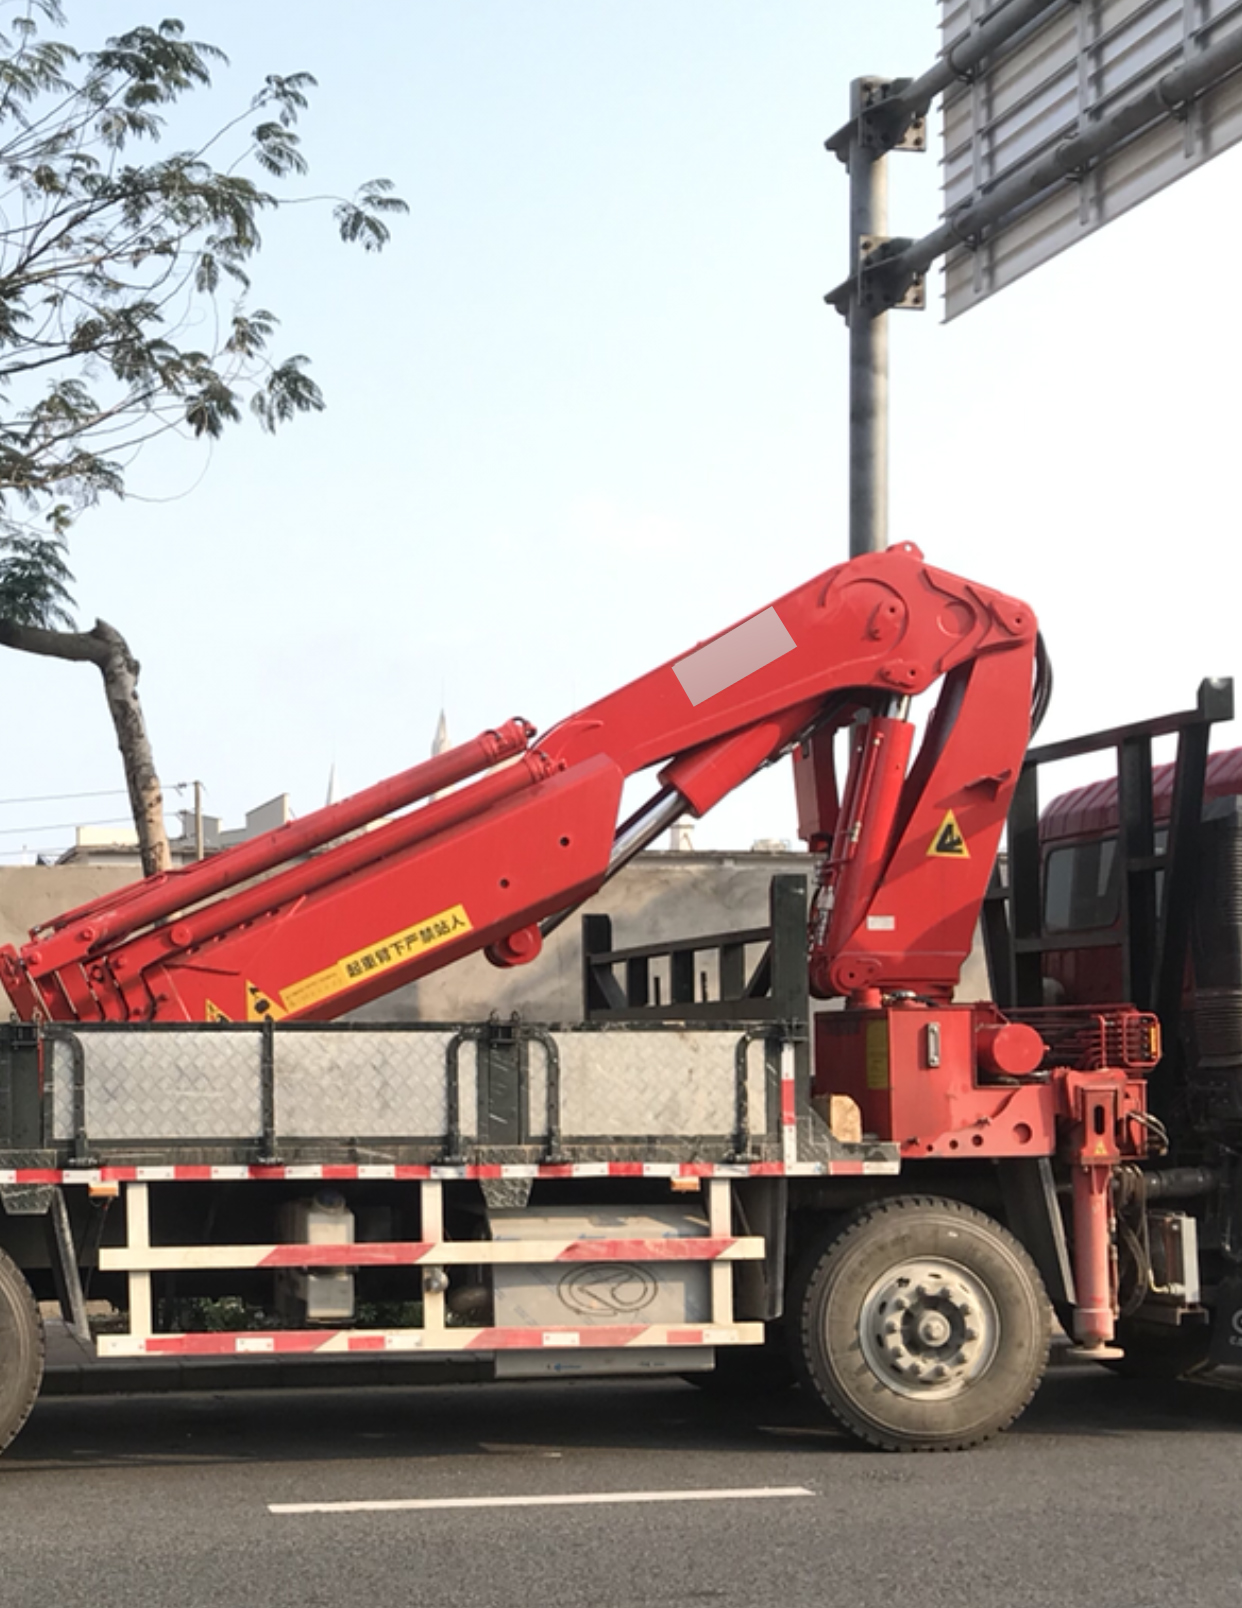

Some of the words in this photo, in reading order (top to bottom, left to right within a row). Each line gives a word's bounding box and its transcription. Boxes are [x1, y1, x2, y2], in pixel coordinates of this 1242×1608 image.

[346, 914, 465, 978] 起重臂下严禁站人
